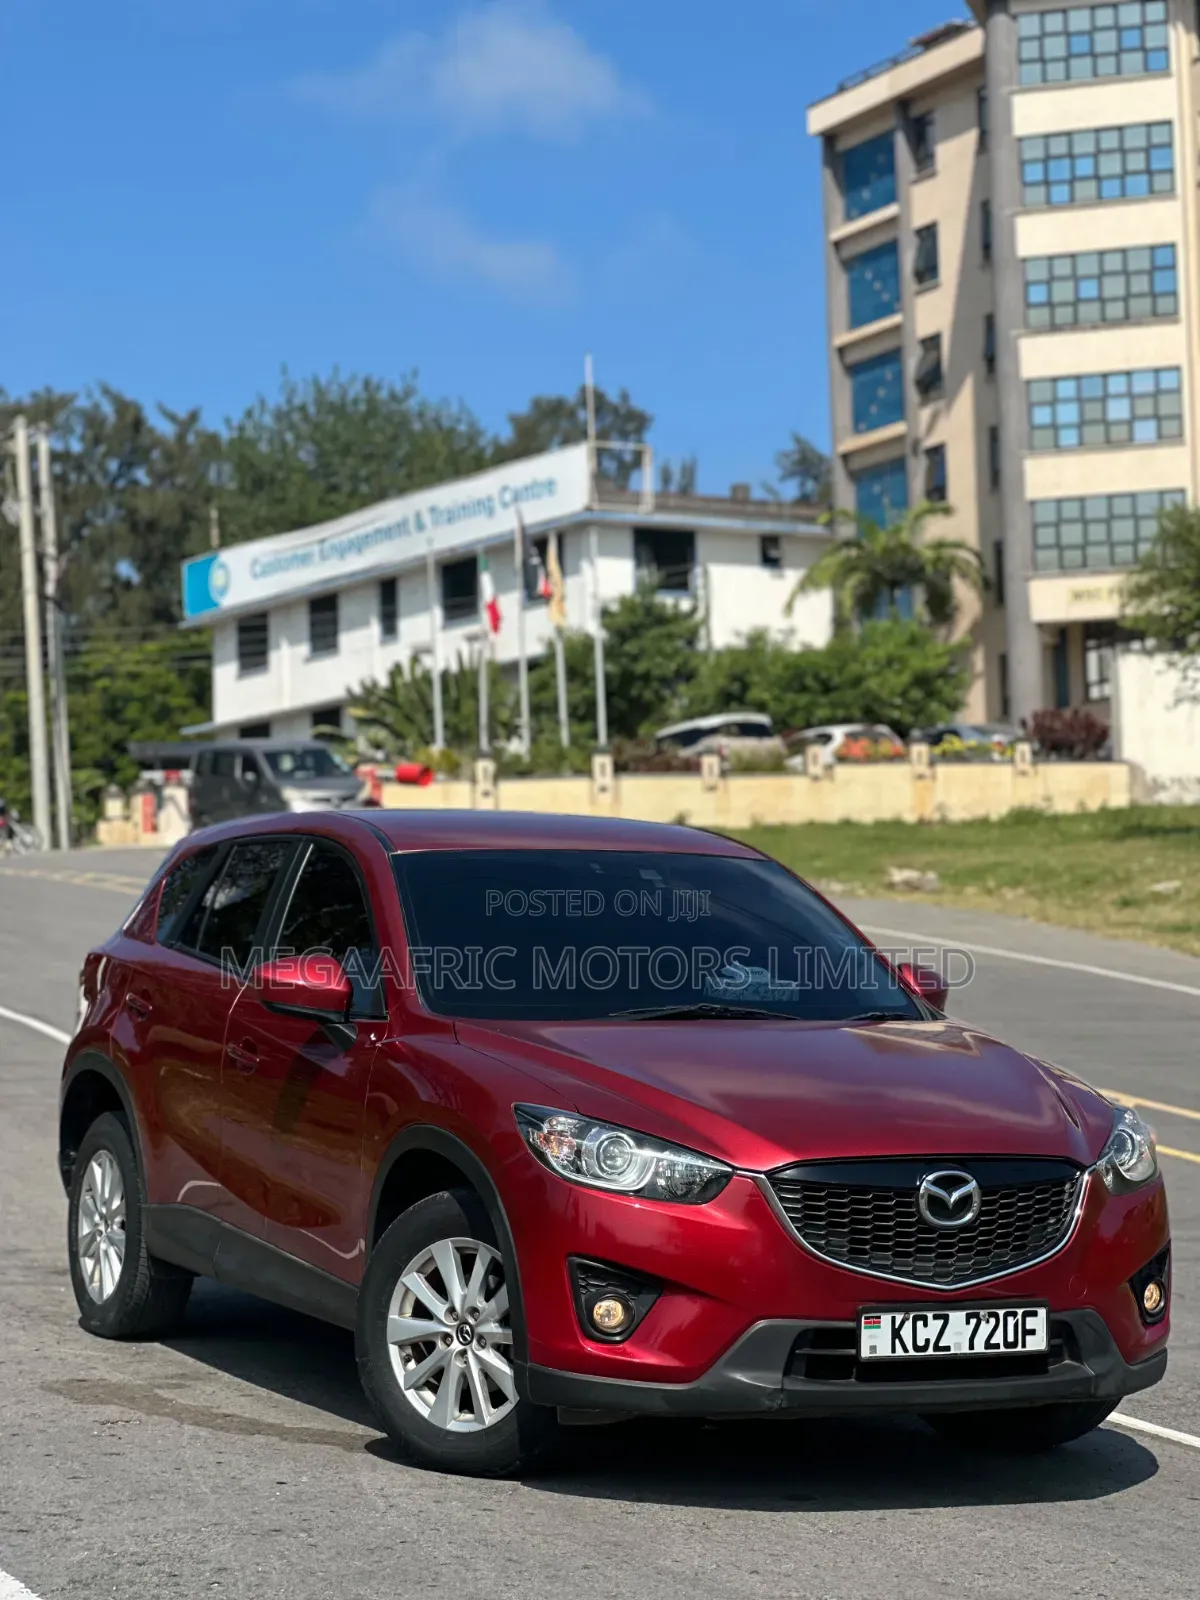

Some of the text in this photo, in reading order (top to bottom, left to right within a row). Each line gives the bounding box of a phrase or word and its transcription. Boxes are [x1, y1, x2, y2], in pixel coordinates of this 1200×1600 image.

[319, 516, 411, 561] Engagement
[414, 510, 425, 533] &
[428, 495, 495, 526] Training
[499, 477, 556, 509] Centre
[890, 1309, 1039, 1354] KCZ 720F
